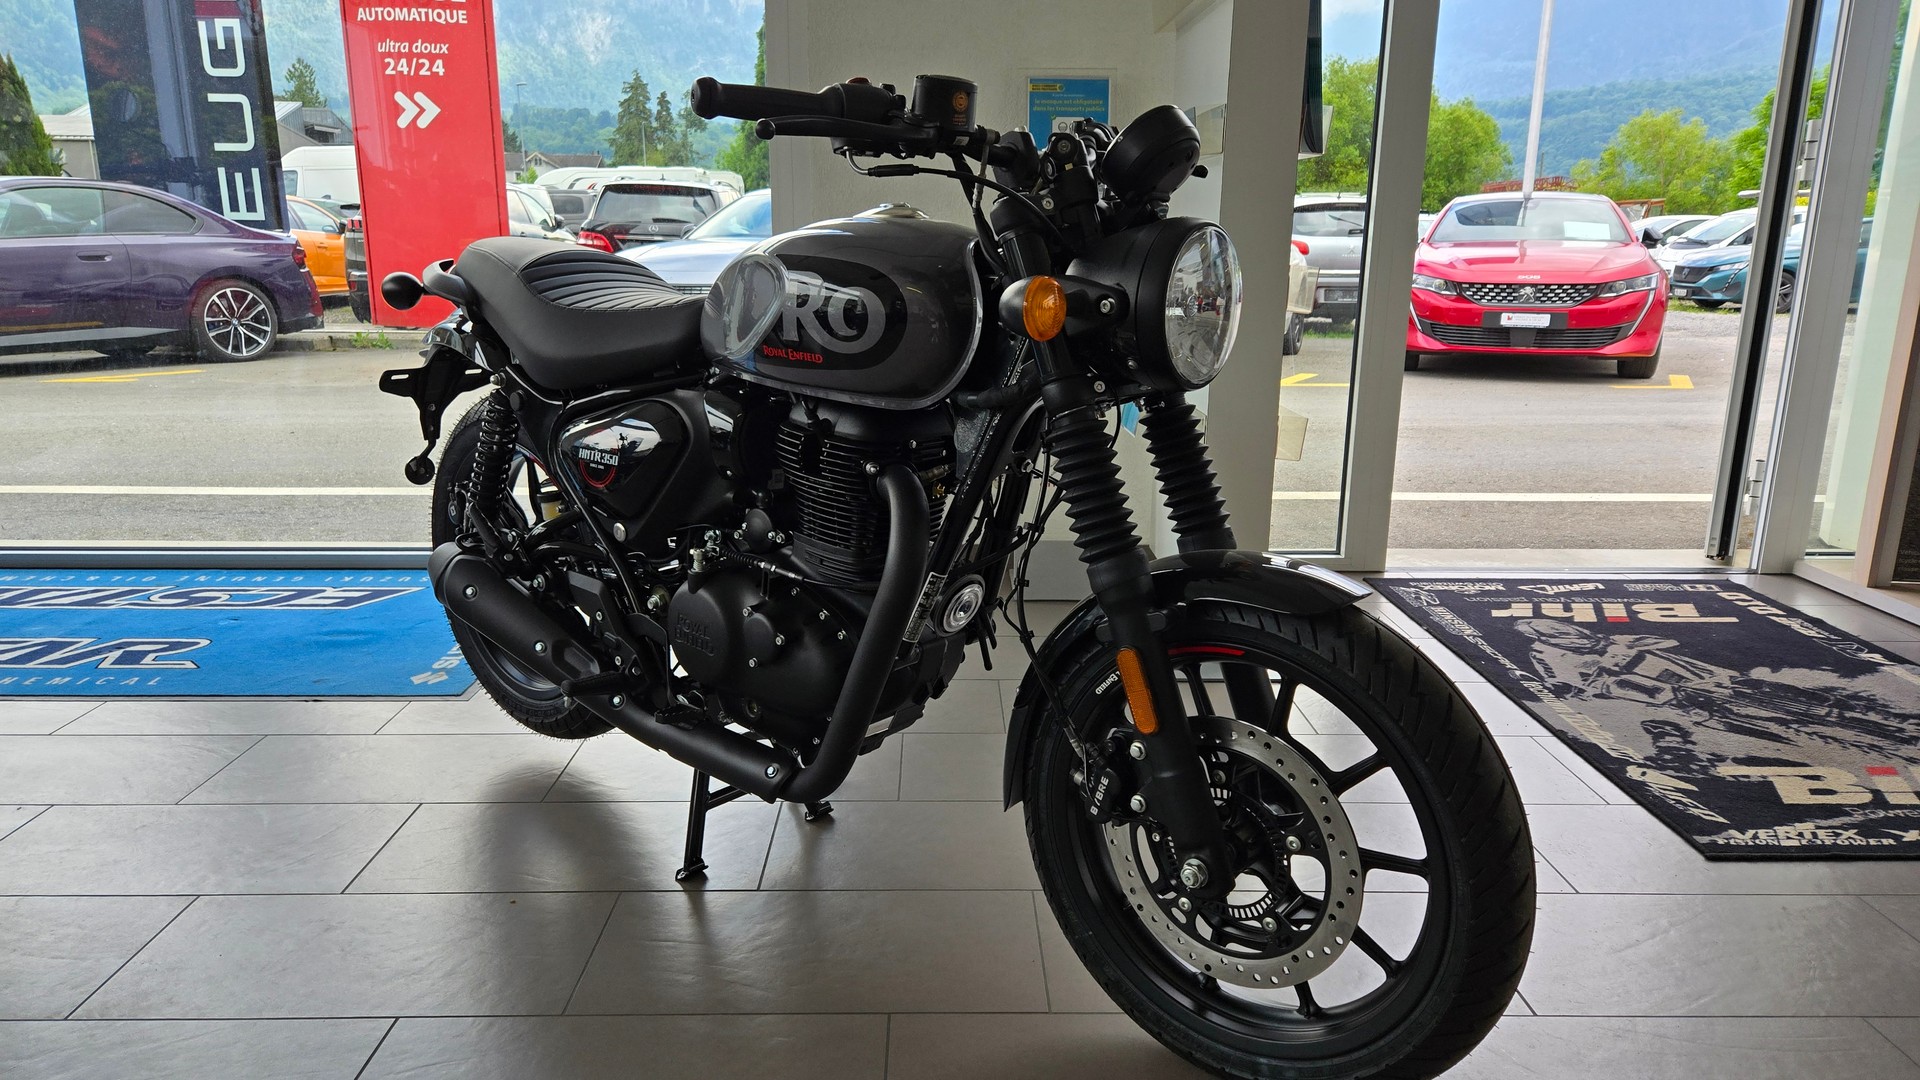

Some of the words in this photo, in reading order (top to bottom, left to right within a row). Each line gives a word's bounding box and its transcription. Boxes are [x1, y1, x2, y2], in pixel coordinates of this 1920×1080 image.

[357, 7, 467, 24] AUTOMATIQUE
[378, 38, 408, 53] ultra
[412, 39, 449, 54] doux
[384, 58, 445, 76] 24/24
[762, 345, 788, 359] ROYAL
[788, 348, 823, 364] ENFIELD
[1491, 602, 1739, 622] Bihr
[1728, 825, 1862, 840] VERTEX
